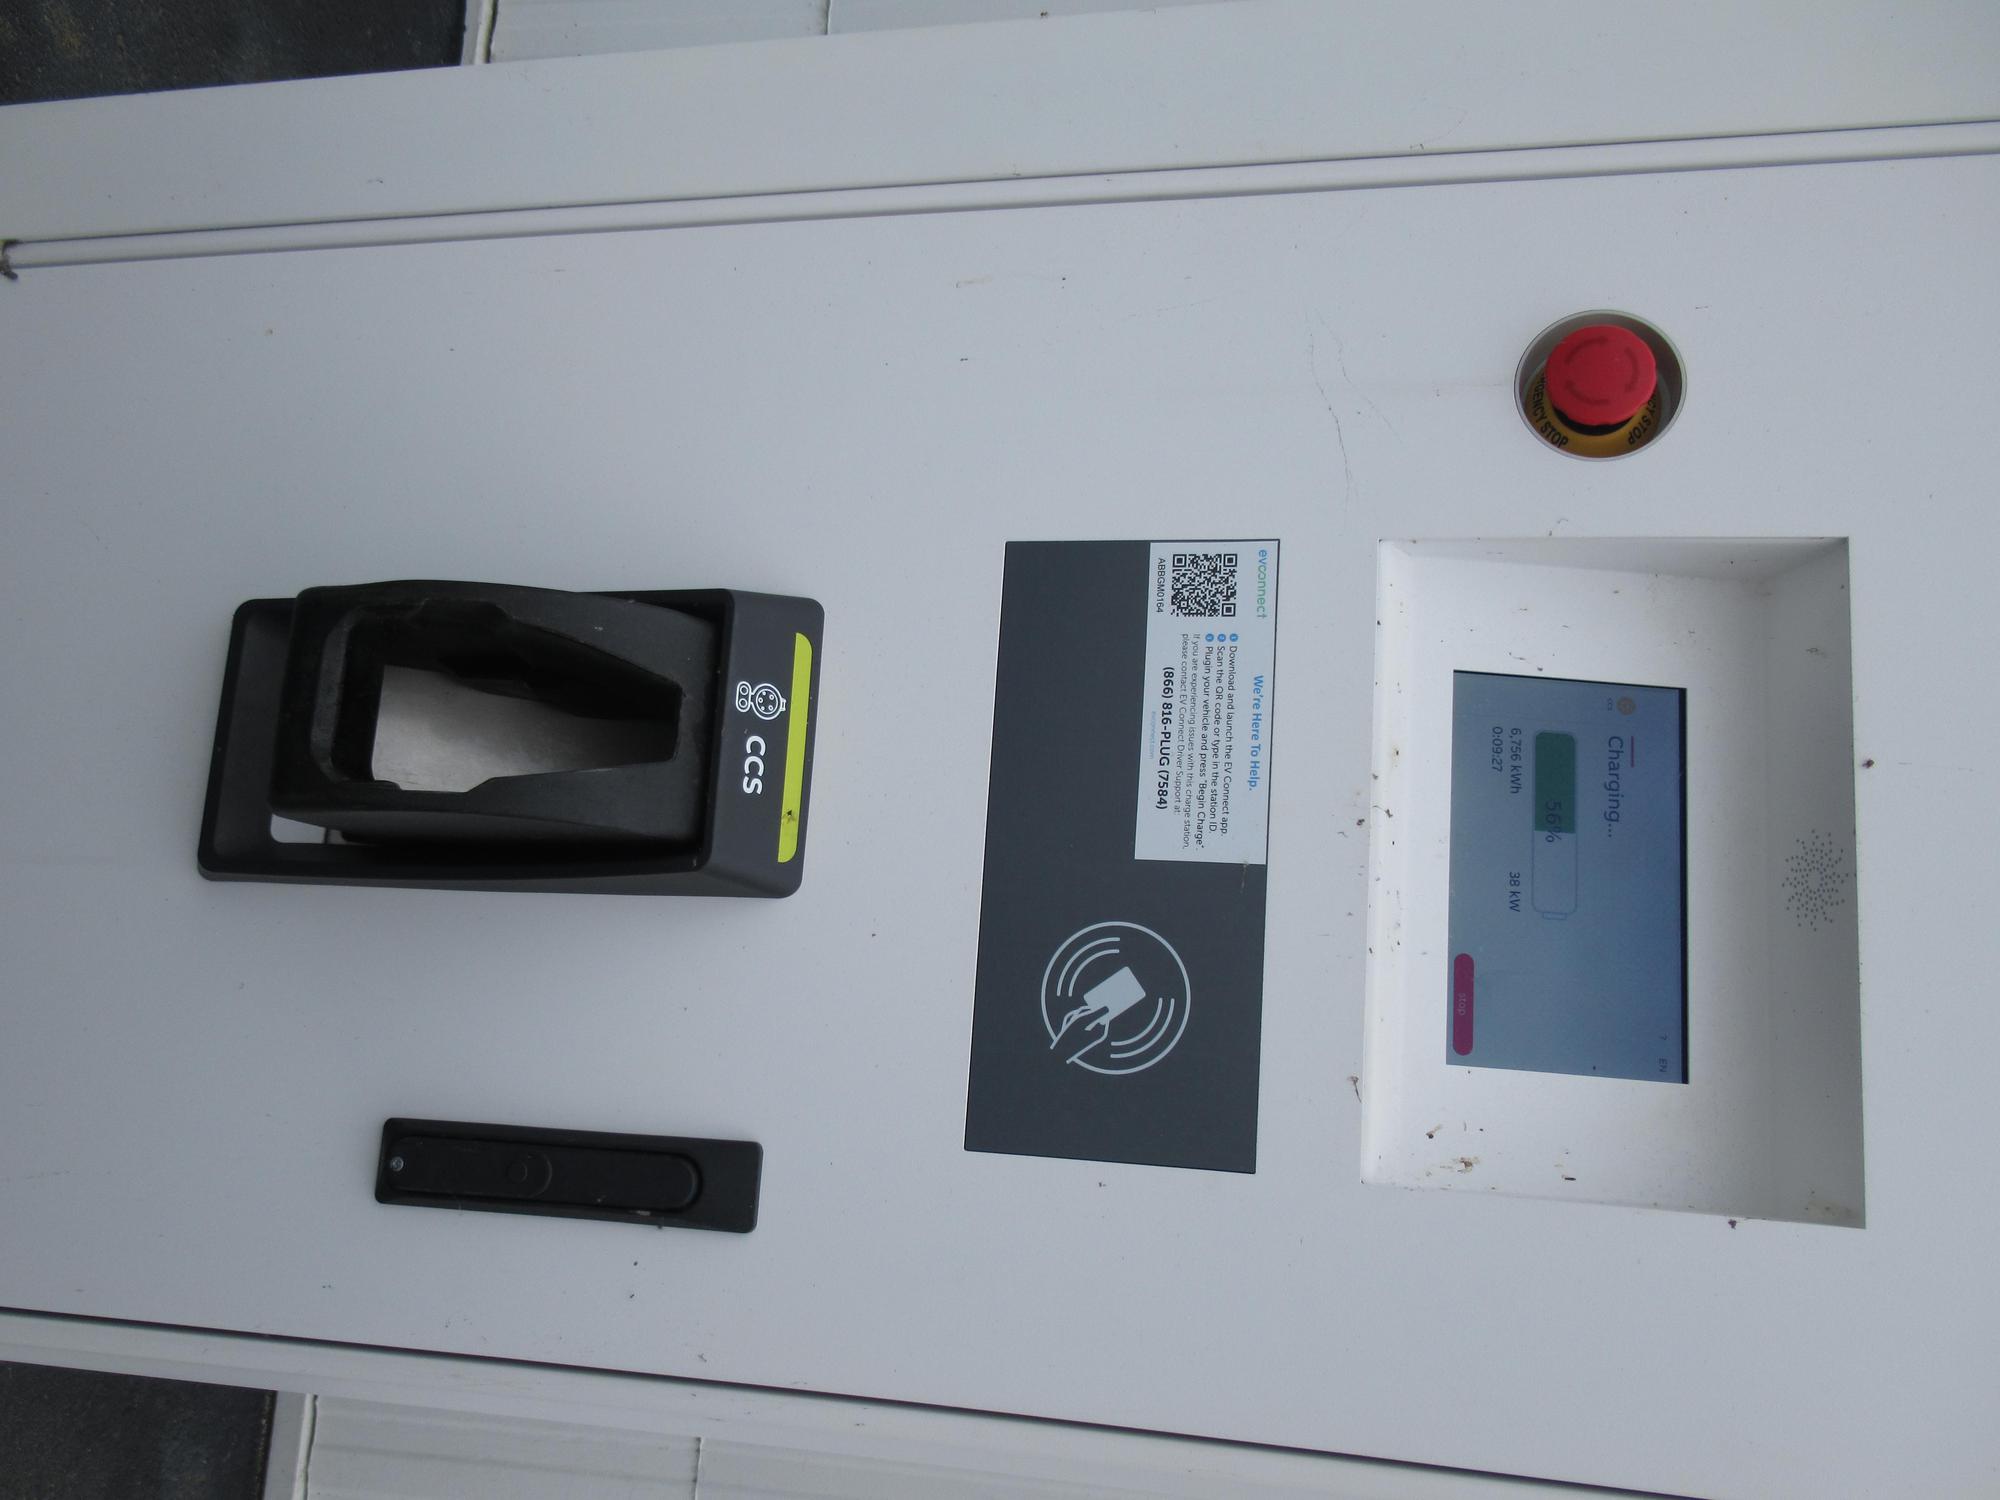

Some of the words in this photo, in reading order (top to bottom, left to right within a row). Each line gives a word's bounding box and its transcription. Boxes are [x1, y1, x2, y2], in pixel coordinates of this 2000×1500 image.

[1541, 422, 1569, 448] STOP
[1628, 416, 1651, 444] STOP
[1156, 557, 1166, 613] ABBGM0164
[1256, 550, 1268, 618] evconnect
[1181, 634, 1190, 659] please
[1203, 646, 1214, 674] Plugin
[1216, 646, 1226, 668] Scan
[1180, 661, 1188, 692] contact
[1216, 670, 1224, 684] the
[1228, 646, 1238, 690] Download
[1162, 667, 1174, 698] (866)
[1202, 676, 1210, 696] your
[1215, 686, 1224, 700] QR
[1180, 694, 1188, 705] EV
[1188, 673, 1198, 724] experiencing
[1226, 693, 1236, 710] and
[1178, 707, 1187, 742] Connect
[1202, 700, 1211, 732] vehicle
[1214, 702, 1222, 726] code
[1226, 712, 1234, 742] launch
[1251, 713, 1262, 740] Here
[1159, 702, 1172, 766] 816-PLUG
[1201, 734, 1209, 750] and
[1214, 728, 1220, 736] or
[1509, 728, 1522, 762] 6,756
[1176, 744, 1185, 768] Driver
[1212, 740, 1220, 758] type
[1224, 745, 1232, 760] the
[1250, 744, 1261, 757] To
[1491, 726, 1504, 772] 0:09:27
[742, 736, 766, 794] CCS
[1212, 762, 1220, 770] in
[1224, 762, 1232, 774] EV
[1248, 760, 1260, 791] Help.
[1156, 770, 1169, 810] (7584)
[1174, 770, 1184, 803] Support
[1186, 772, 1194, 787] this
[1212, 772, 1220, 786] the
[1510, 765, 1522, 794] kWh
[1604, 736, 1624, 838] Charging...
[1183, 790, 1193, 818] charge
[1209, 789, 1218, 818] station
[1222, 776, 1232, 814] Connect
[1545, 800, 1562, 842] 56%
[1509, 871, 1520, 886] 38
[1509, 890, 1520, 912] kW
[1457, 992, 1467, 1016] stop
[1659, 1058, 1668, 1072] EN
